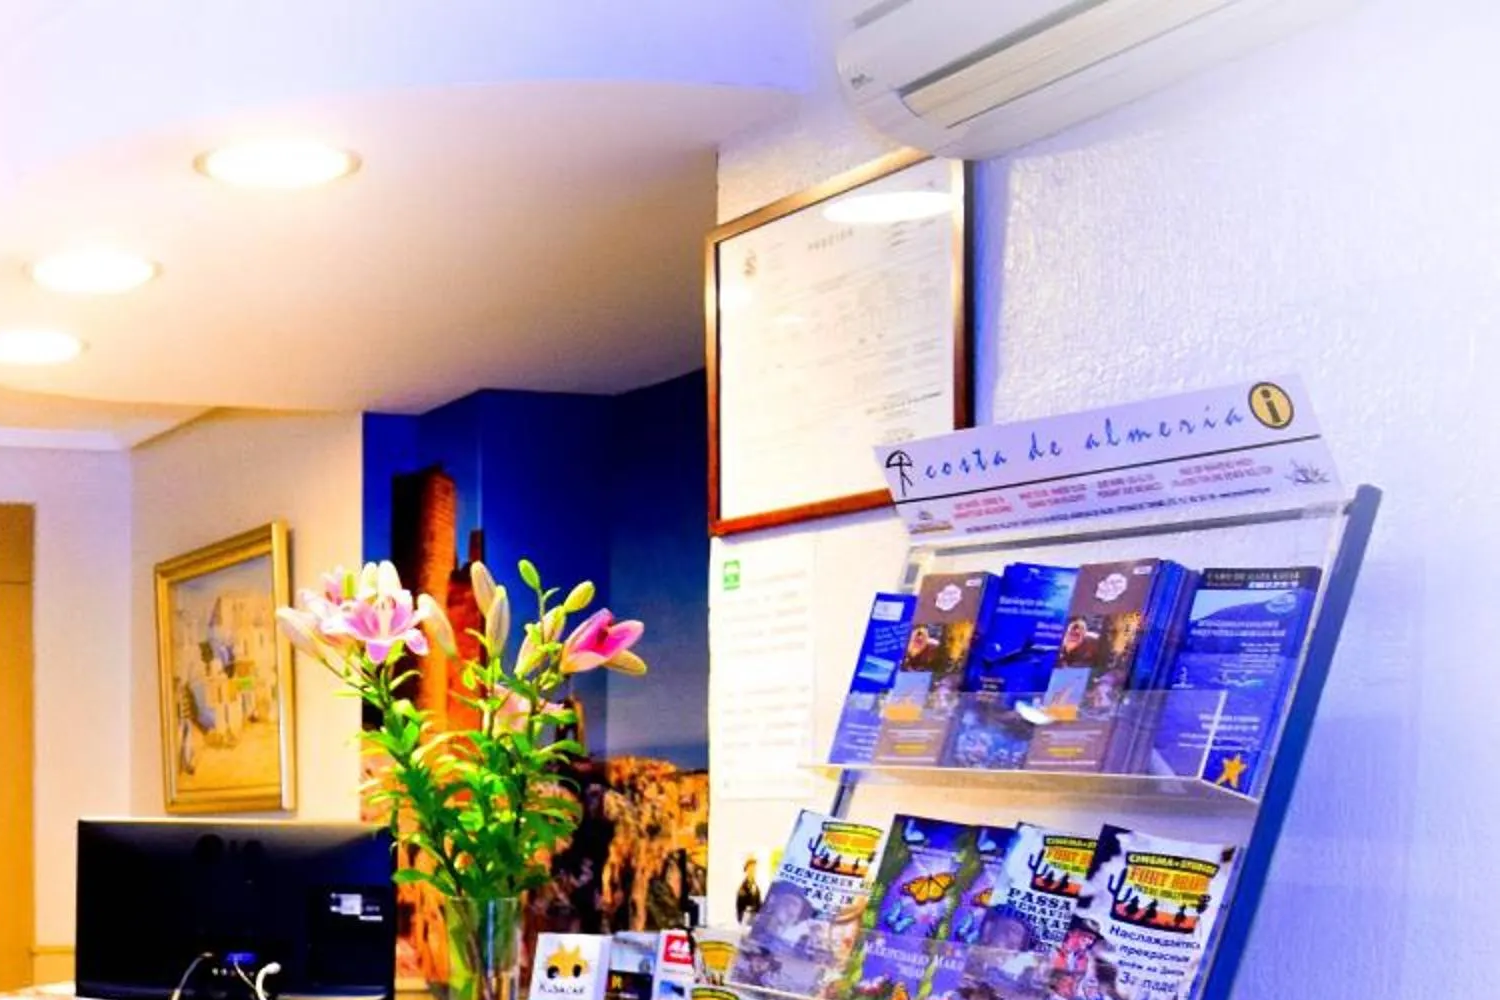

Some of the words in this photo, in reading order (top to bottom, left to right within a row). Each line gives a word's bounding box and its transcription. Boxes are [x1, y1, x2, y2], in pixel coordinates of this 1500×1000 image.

[925, 448, 1007, 480] costa
[1028, 431, 1062, 461] de
[1007, 886, 1072, 912] PASSA
